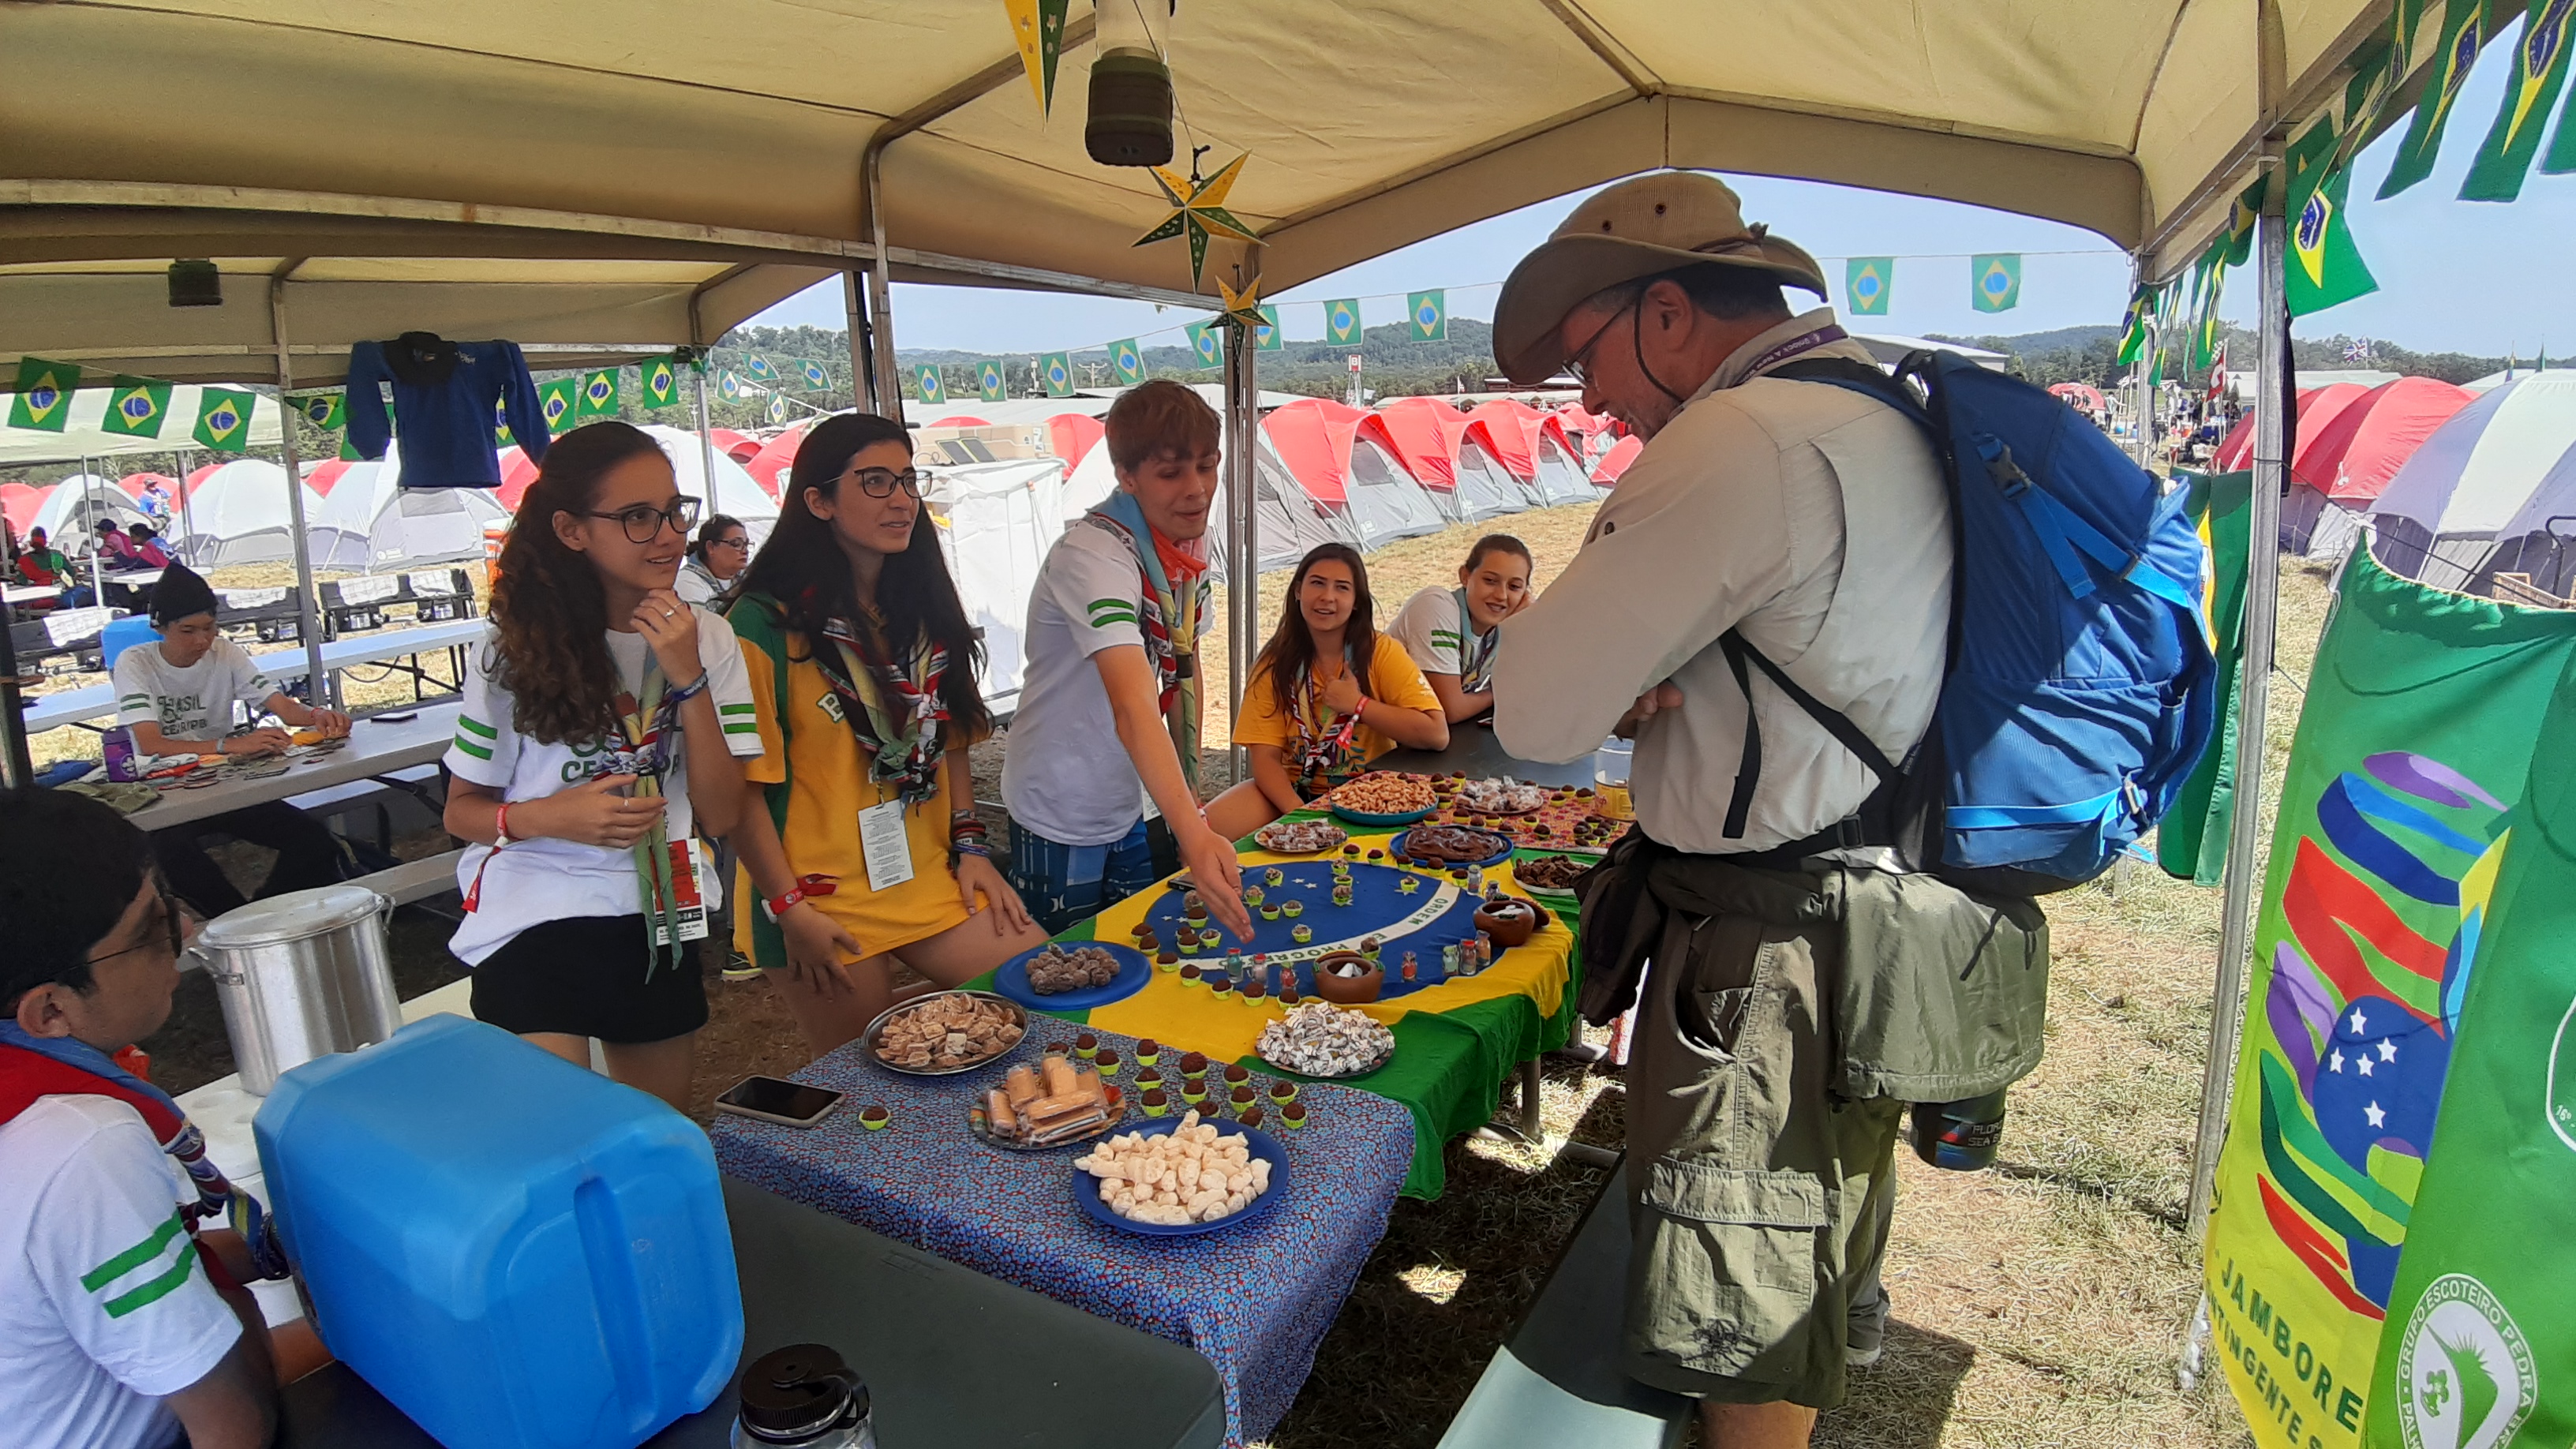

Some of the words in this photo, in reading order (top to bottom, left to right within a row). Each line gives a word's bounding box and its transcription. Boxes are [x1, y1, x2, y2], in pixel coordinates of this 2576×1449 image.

[1408, 897, 1449, 926] ORDEM
[1968, 1137, 1990, 1147] SEA
[2400, 1306, 2426, 1380] GRUPO
[2425, 1279, 2502, 1326] ESCOTEIRO
[2502, 1325, 2533, 1408] PEDRA
